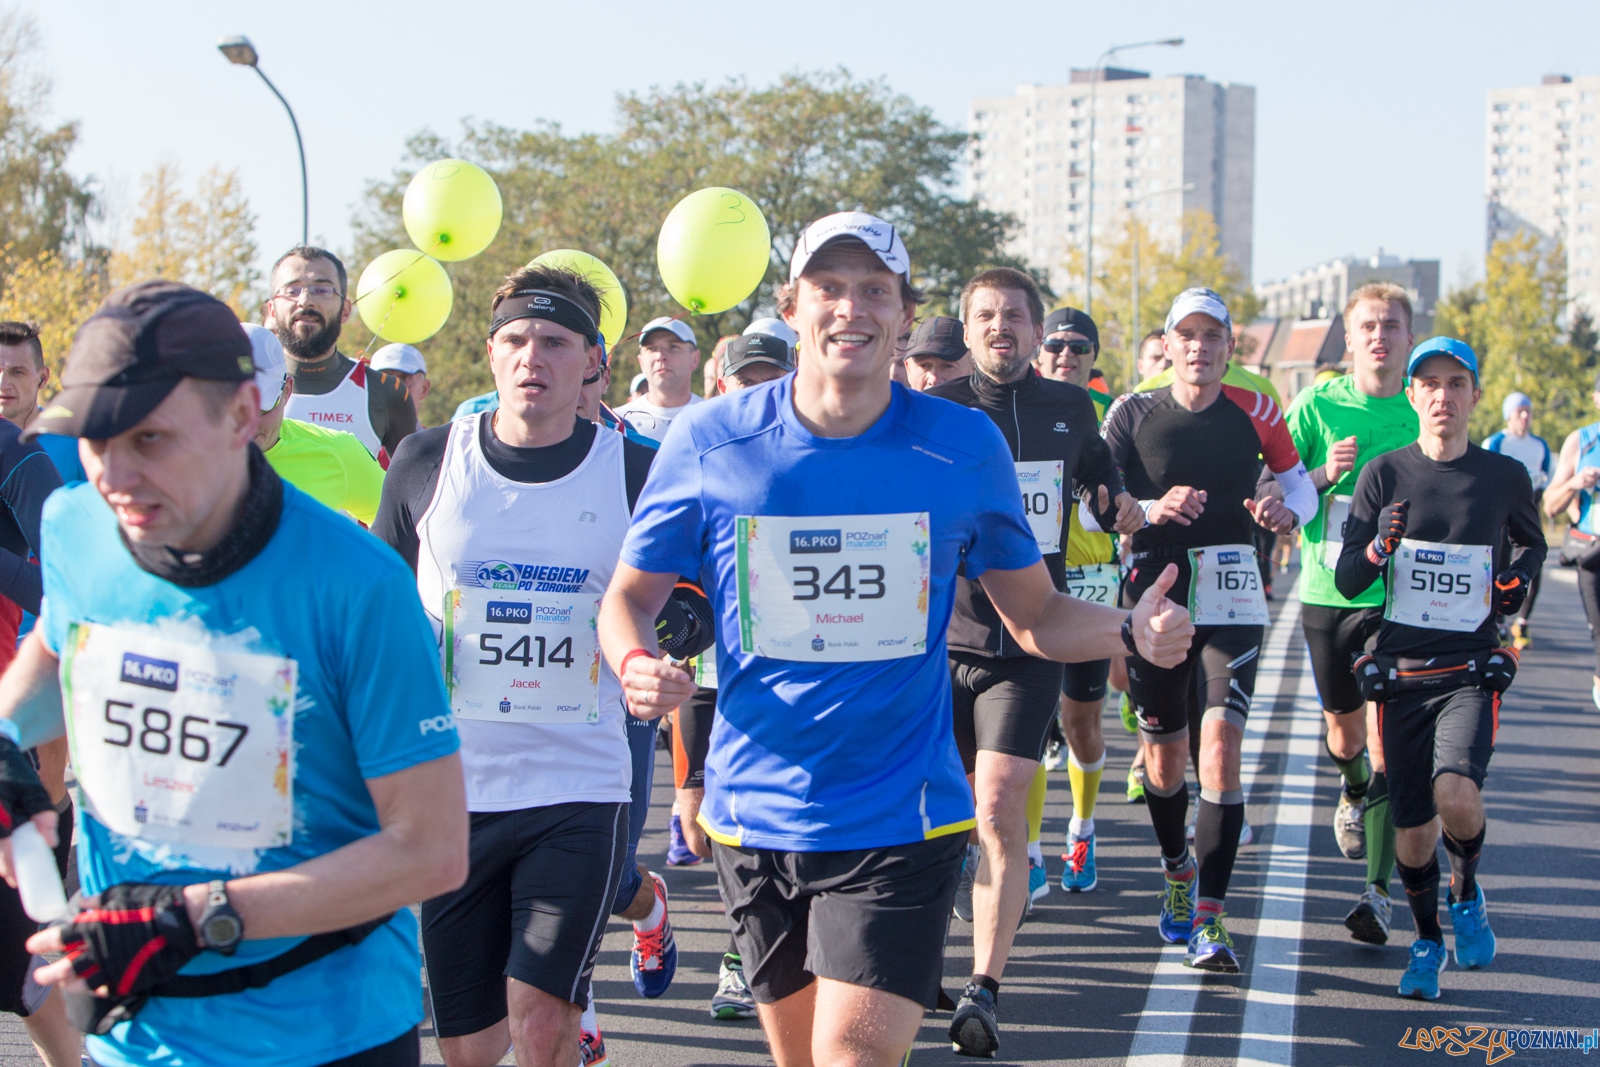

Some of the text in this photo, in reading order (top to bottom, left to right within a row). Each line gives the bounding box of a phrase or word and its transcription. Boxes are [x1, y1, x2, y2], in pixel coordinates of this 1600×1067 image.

[715, 193, 745, 225] 3
[527, 303, 555, 312] Kalenji
[308, 412, 354, 423] TIMEX
[812, 536, 838, 547] PKO
[846, 539, 887, 548] maraton
[478, 567, 515, 582] asa
[521, 564, 590, 584] BIEGIEM
[1216, 570, 1258, 591] 1673
[517, 581, 583, 594] PO ZDROWIE
[793, 564, 886, 601] 343
[1411, 569, 1471, 595] 5195
[506, 607, 528, 618] PKO
[535, 614, 570, 622] maraton
[816, 613, 863, 624] Michael
[479, 633, 574, 668] 5414
[143, 663, 176, 684] PKO
[510, 678, 541, 689] Jacek
[104, 699, 249, 767] 5867
